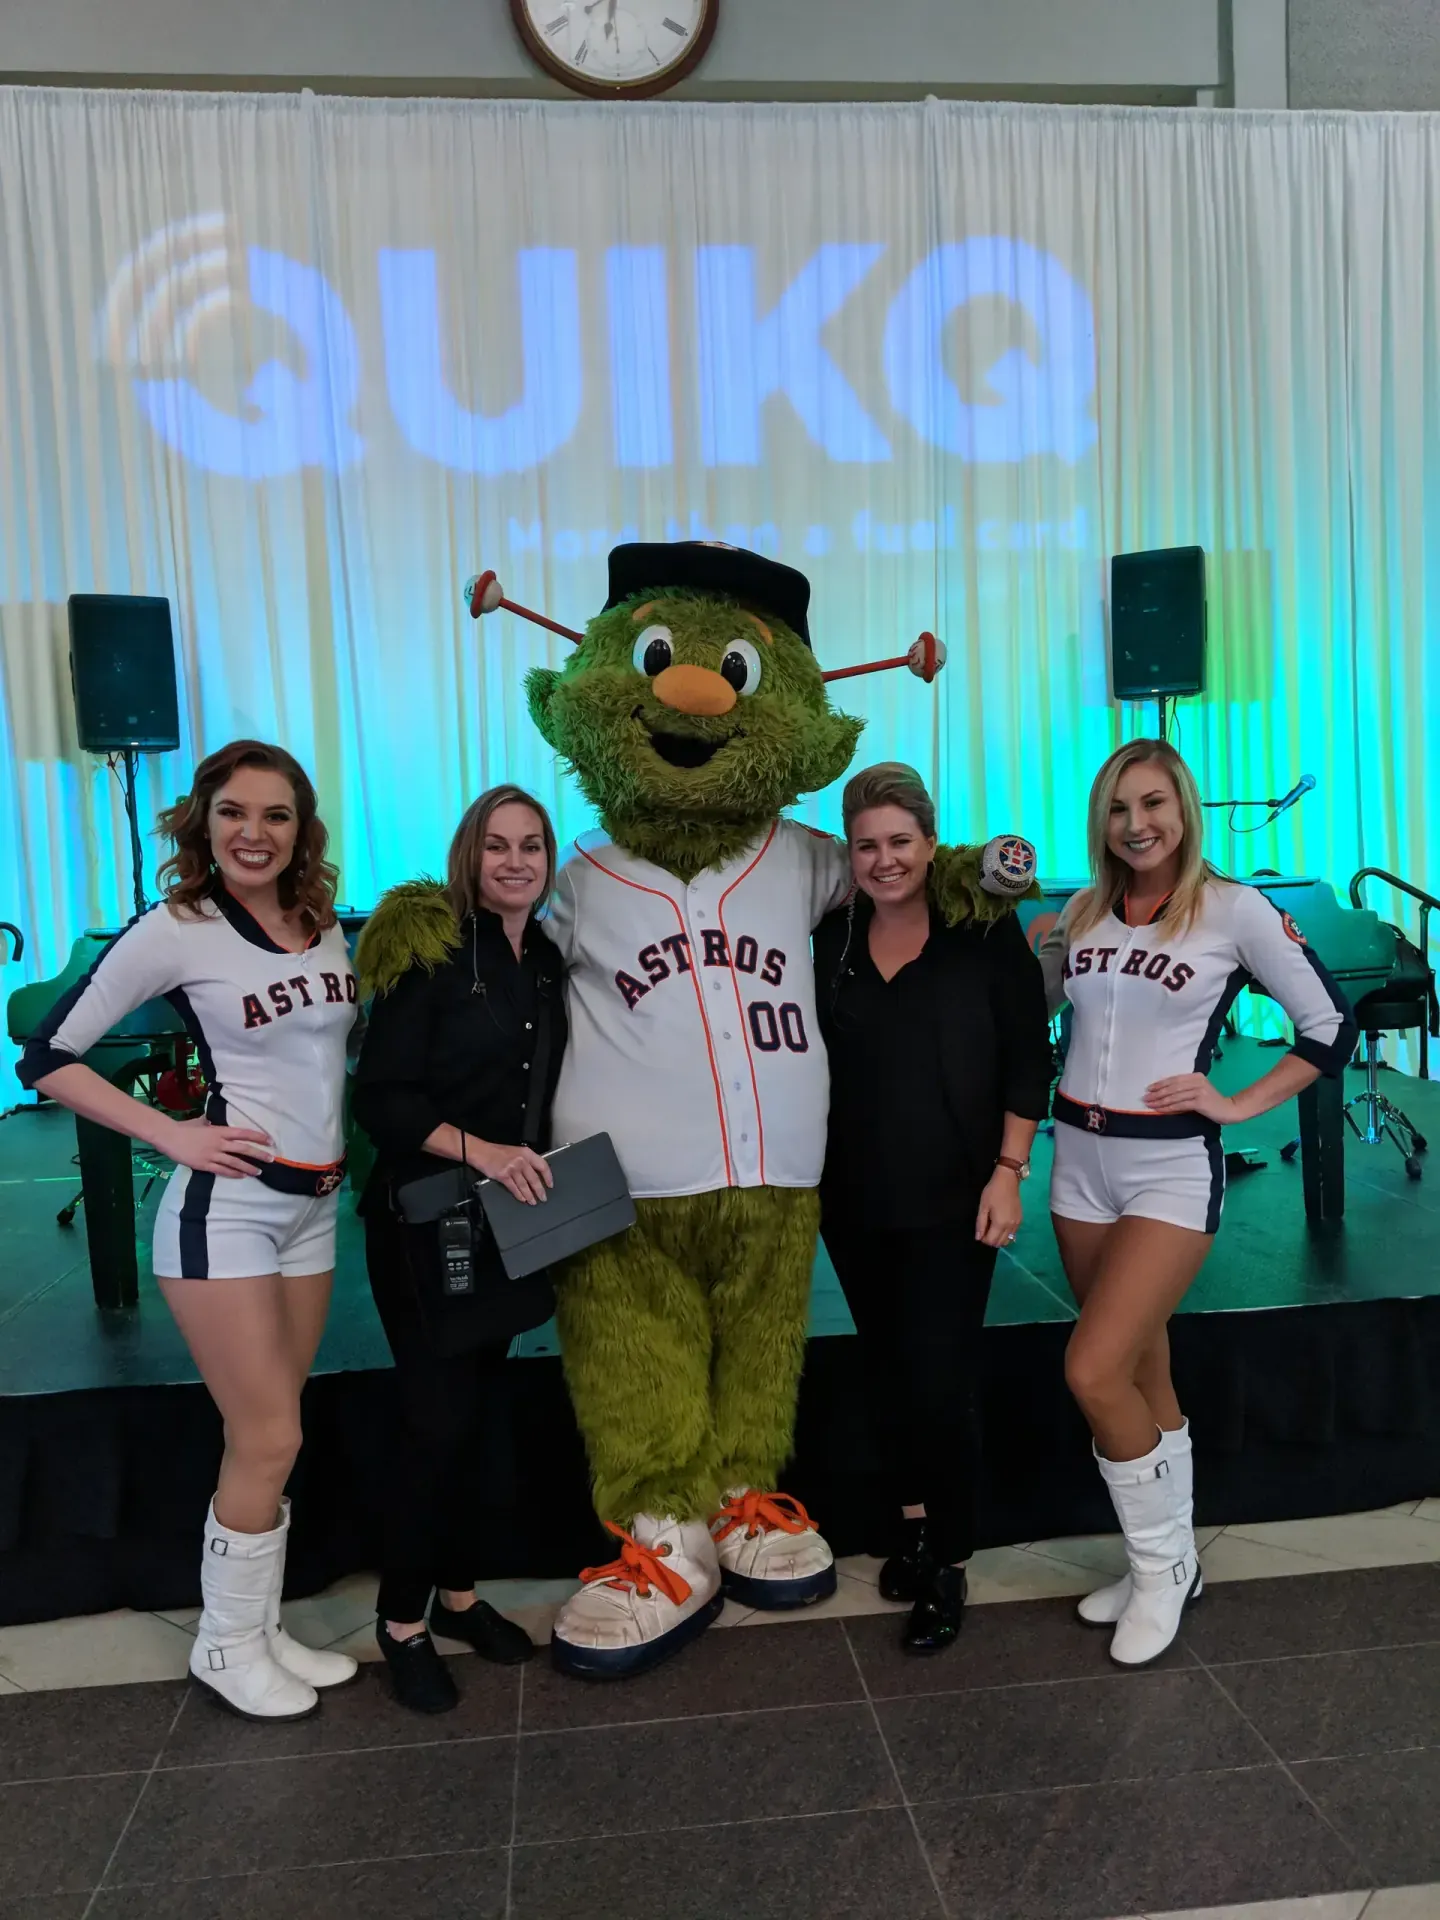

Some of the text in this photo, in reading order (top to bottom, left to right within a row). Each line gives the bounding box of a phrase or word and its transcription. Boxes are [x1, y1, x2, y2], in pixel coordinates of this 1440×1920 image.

[98, 212, 1098, 479] QUIKQ
[976, 505, 1088, 551] card
[614, 929, 786, 1012] ASTROS
[747, 1000, 809, 1054] 00
